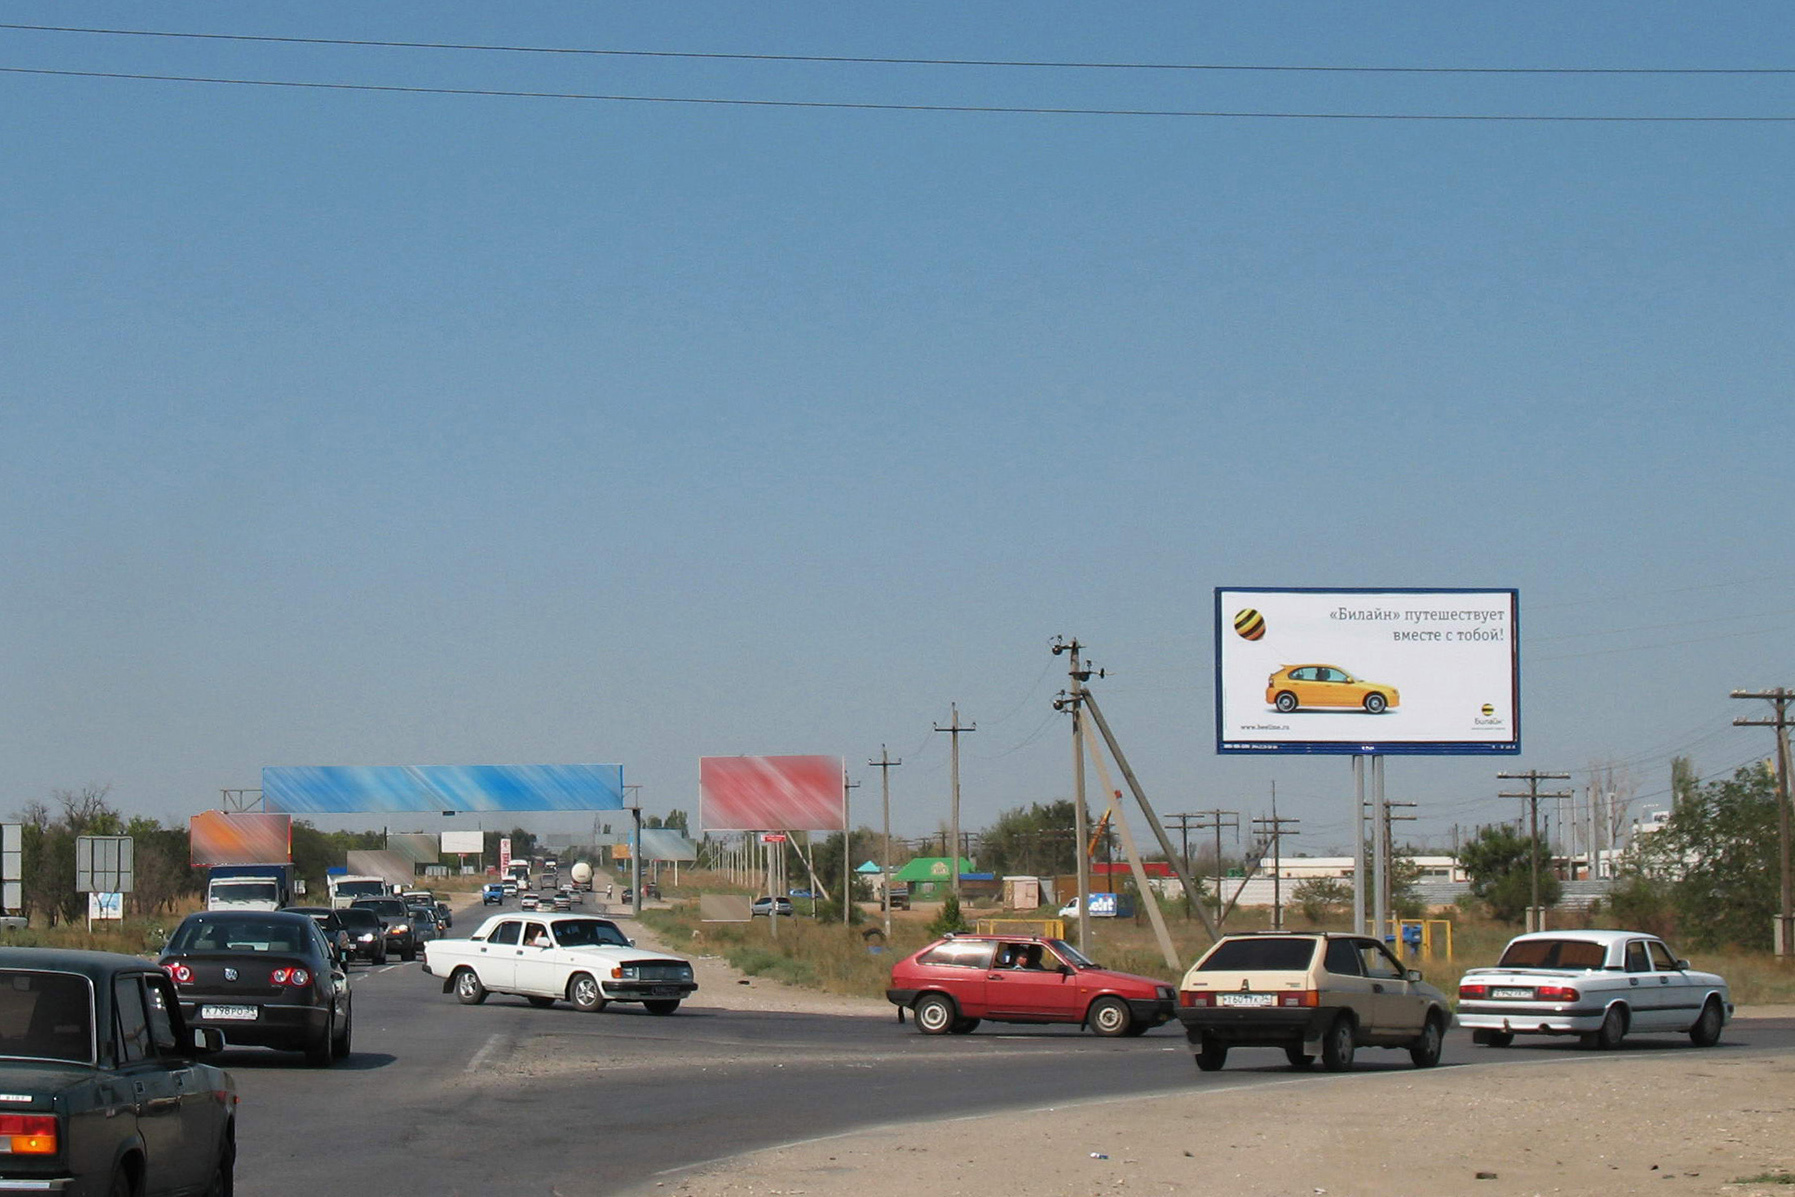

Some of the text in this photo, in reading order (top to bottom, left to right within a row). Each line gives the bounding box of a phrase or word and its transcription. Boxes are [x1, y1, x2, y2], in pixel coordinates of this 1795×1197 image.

[1329, 607, 1505, 624] «Билайн» путешествует
[1393, 628, 1504, 642] вместе с тобой!
